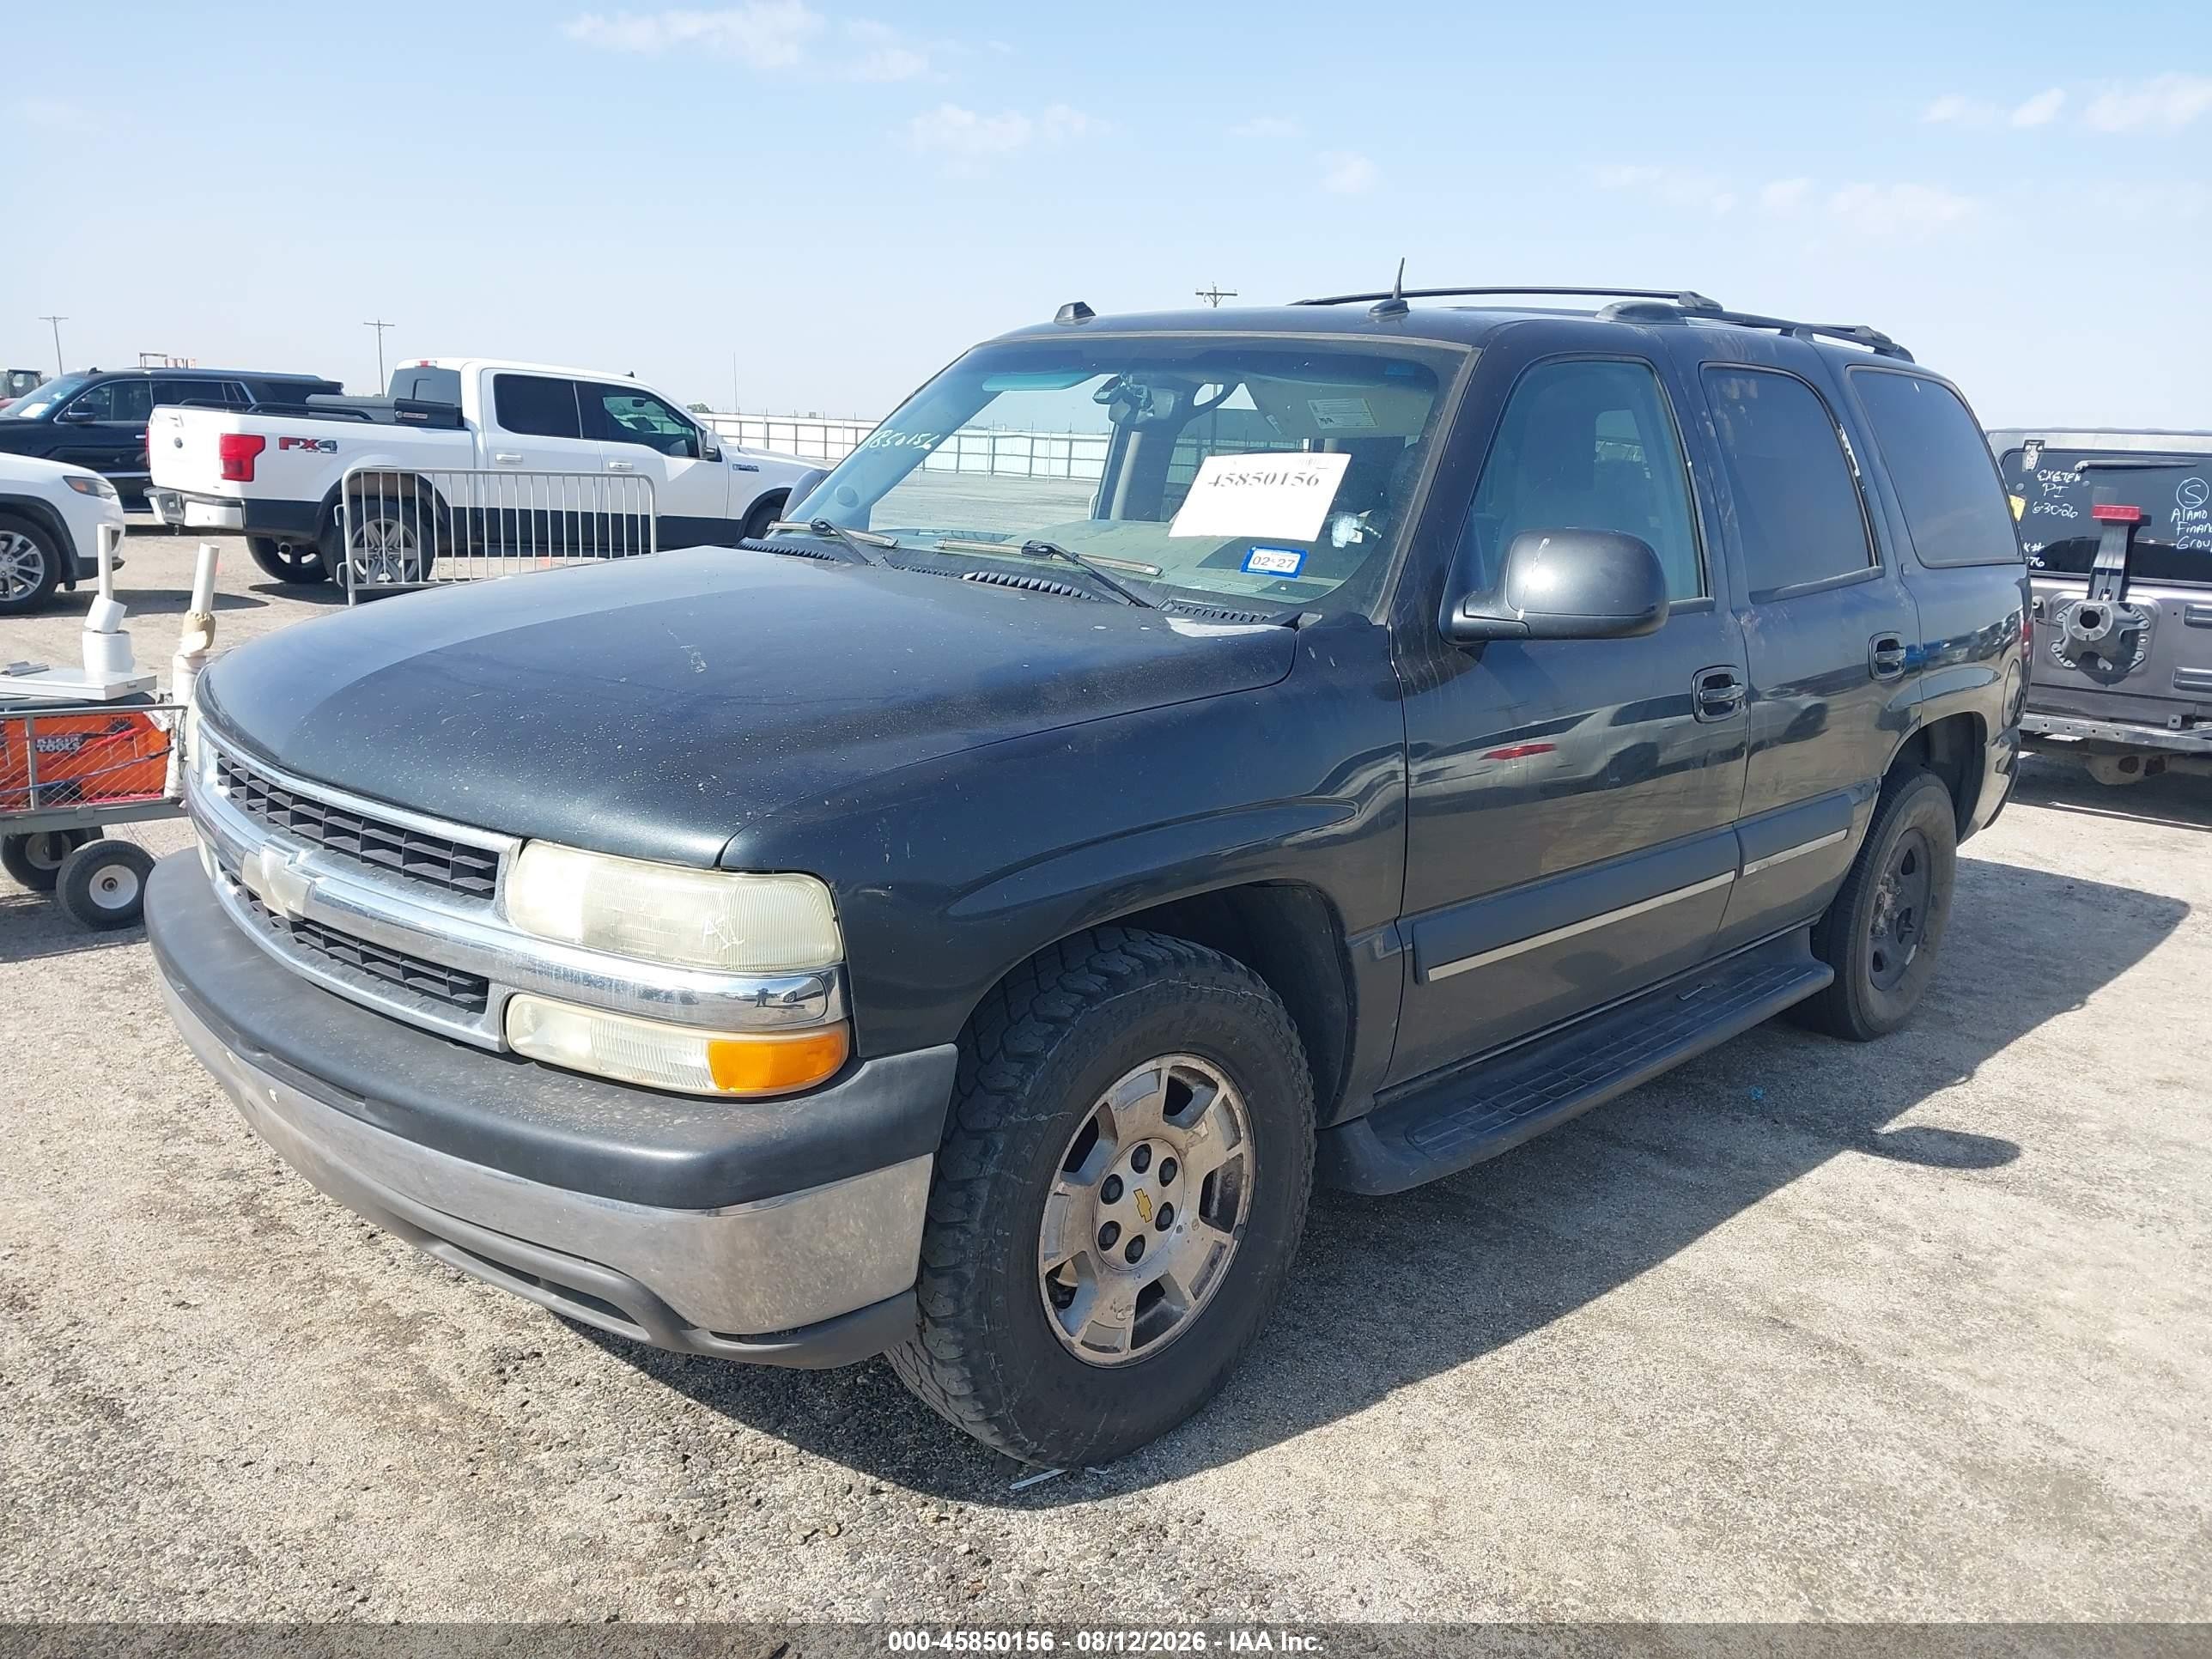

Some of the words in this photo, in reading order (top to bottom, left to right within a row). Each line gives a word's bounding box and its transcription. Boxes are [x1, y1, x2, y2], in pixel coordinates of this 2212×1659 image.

[279, 437, 337, 451] FX4
[1208, 471, 1320, 487] 45850156
[2176, 535, 2212, 553] Grou
